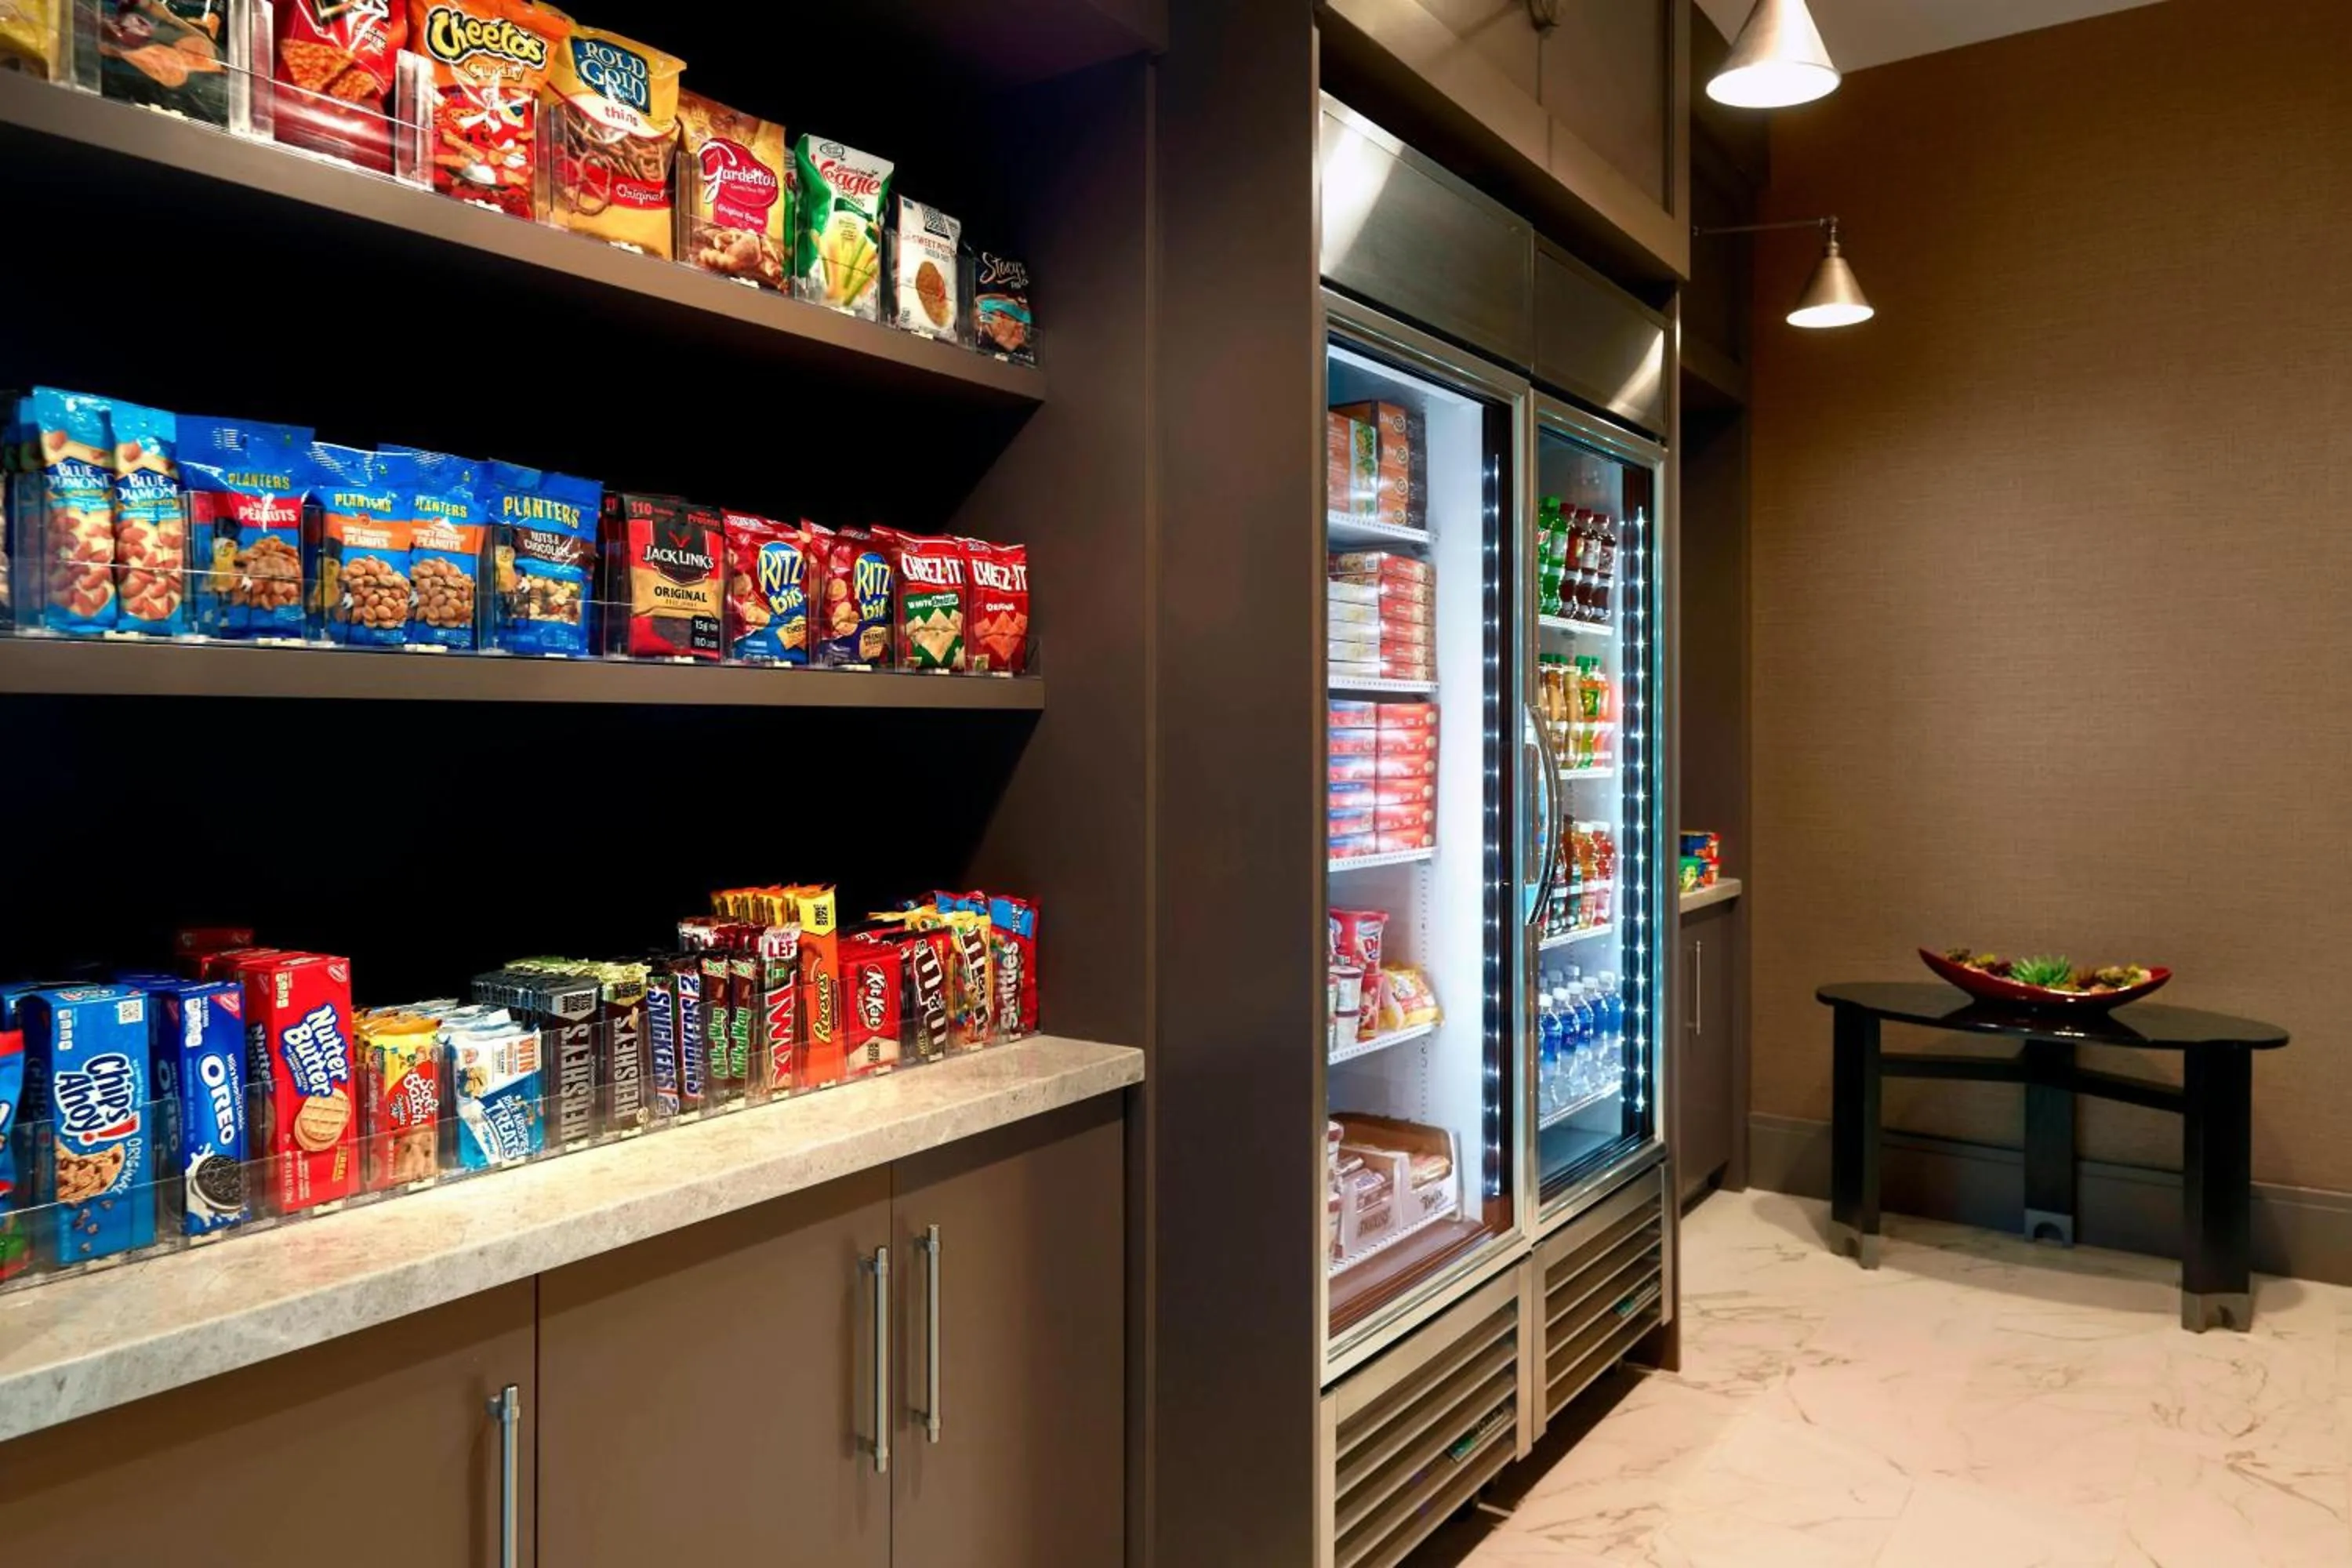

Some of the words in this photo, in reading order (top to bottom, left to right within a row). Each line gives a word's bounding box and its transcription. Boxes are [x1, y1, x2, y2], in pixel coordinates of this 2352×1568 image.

[430, 10, 545, 63] Cheetos
[585, 42, 646, 79] ROLD
[580, 59, 647, 107] GOLD
[616, 183, 665, 205] Original
[56, 462, 96, 477] BLUE
[128, 473, 168, 488] BLUE
[228, 473, 290, 491] PLANTERS
[116, 485, 177, 503] DIAMON
[335, 493, 392, 513] PLANTERS
[415, 495, 468, 519] PLANTERS
[630, 500, 652, 515] 110
[238, 506, 297, 522] PEANUTS
[503, 496, 580, 529] PLANTERS
[643, 545, 679, 564] JACK
[902, 553, 963, 584] CHEEZ-IT
[759, 550, 804, 596] RITZ
[853, 557, 891, 601] RITZ
[654, 586, 708, 603] ORIGINAL
[769, 586, 804, 615] bits
[861, 596, 886, 621] bit
[907, 600, 932, 609] WHITE
[767, 941, 795, 958] LEF
[865, 971, 886, 996] Kit
[1000, 941, 1019, 1029] Skittles
[865, 996, 887, 1028] Kat
[307, 1004, 348, 1081] Nutter
[647, 987, 677, 1089] SNICKERS
[767, 977, 796, 1083] TWIX
[283, 1022, 332, 1096] Butter
[518, 1036, 535, 1073] WIN
[85, 1054, 132, 1124] Chips
[200, 1054, 235, 1145] OREO
[403, 1073, 427, 1125] Batch
[419, 1078, 439, 1114] Soft
[485, 1099, 519, 1160] TREATS
[111, 1138, 143, 1195] ORIGINAL
